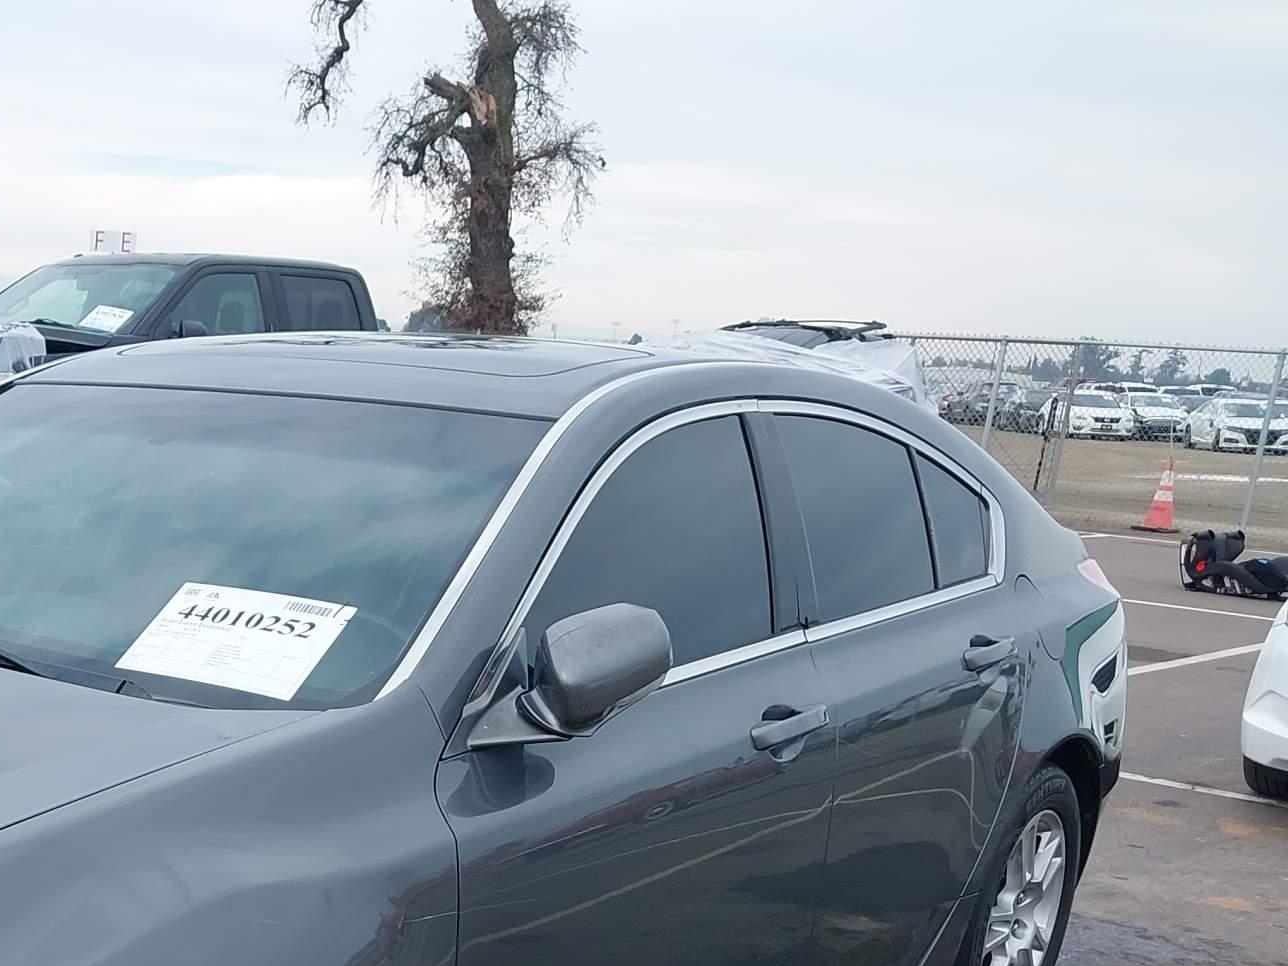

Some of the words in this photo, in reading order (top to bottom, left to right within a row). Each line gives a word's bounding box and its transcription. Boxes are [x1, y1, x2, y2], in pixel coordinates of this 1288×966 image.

[94, 231, 105, 251] F
[121, 231, 132, 253] E
[178, 604, 317, 638] 44010252
